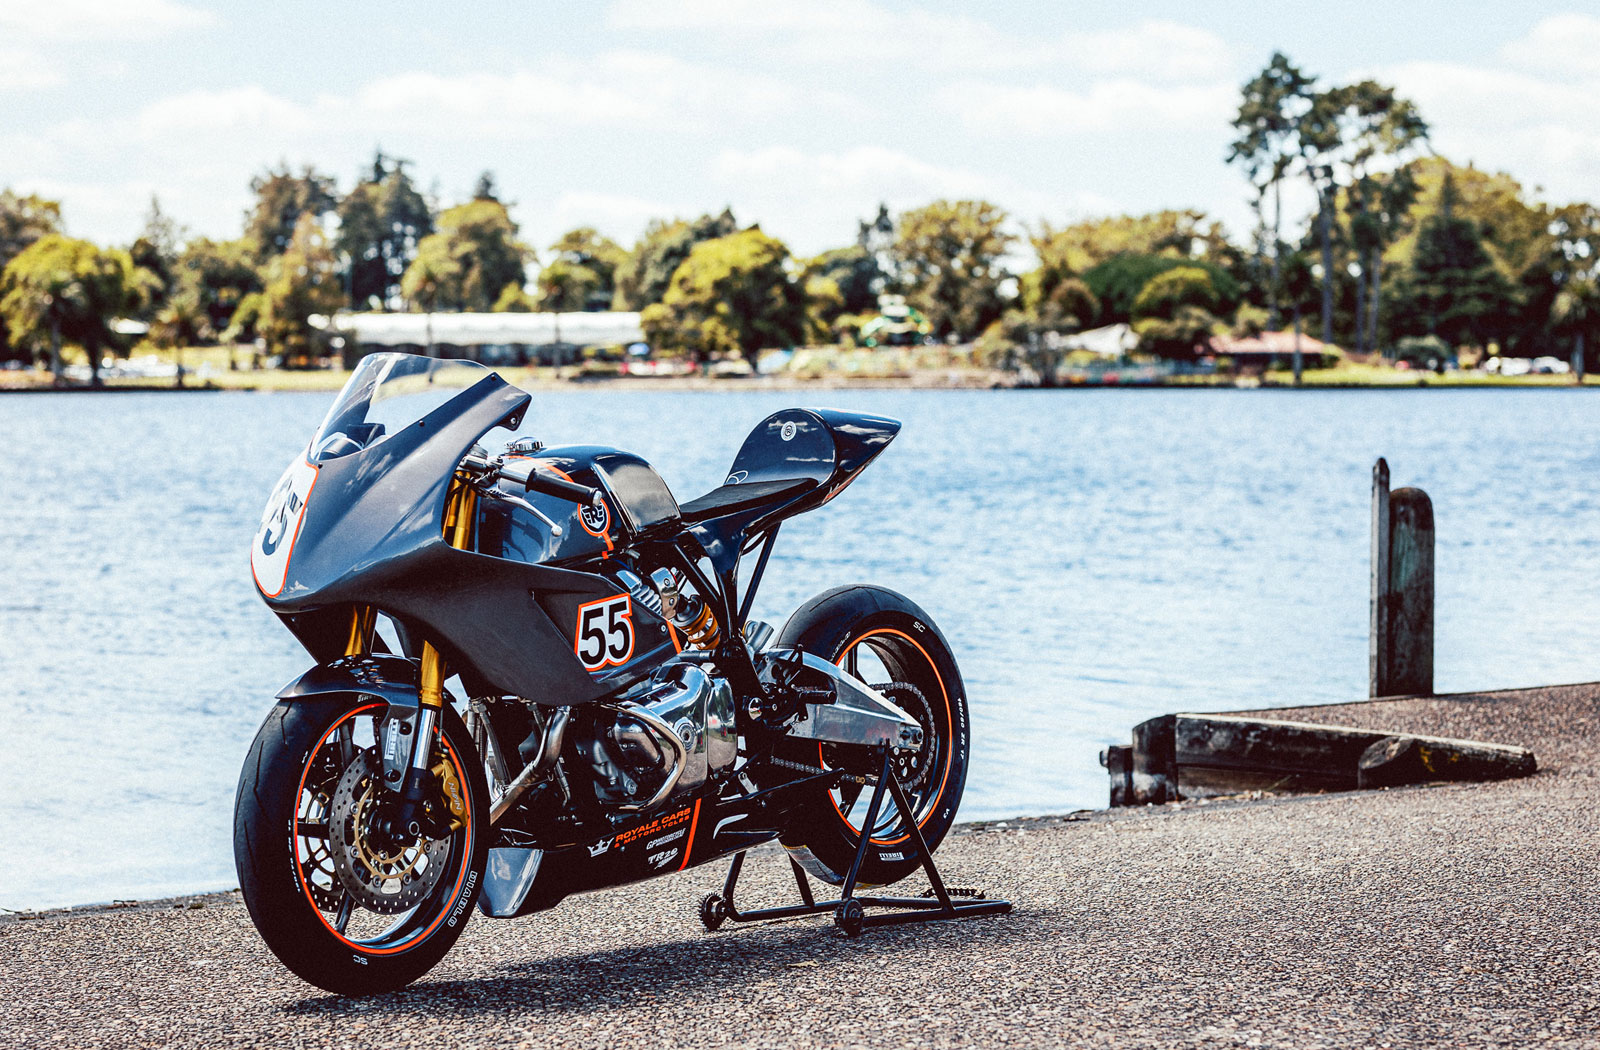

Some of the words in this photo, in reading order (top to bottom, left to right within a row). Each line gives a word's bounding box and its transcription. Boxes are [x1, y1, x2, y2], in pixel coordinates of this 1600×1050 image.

[579, 600, 631, 665] 55
[912, 621, 926, 633] SC
[615, 819, 659, 843] ROYALE
[661, 807, 691, 824] CARS
[623, 815, 690, 845] MOTORCYCLES
[447, 870, 479, 928] DIABLO
[352, 954, 368, 965] SC
